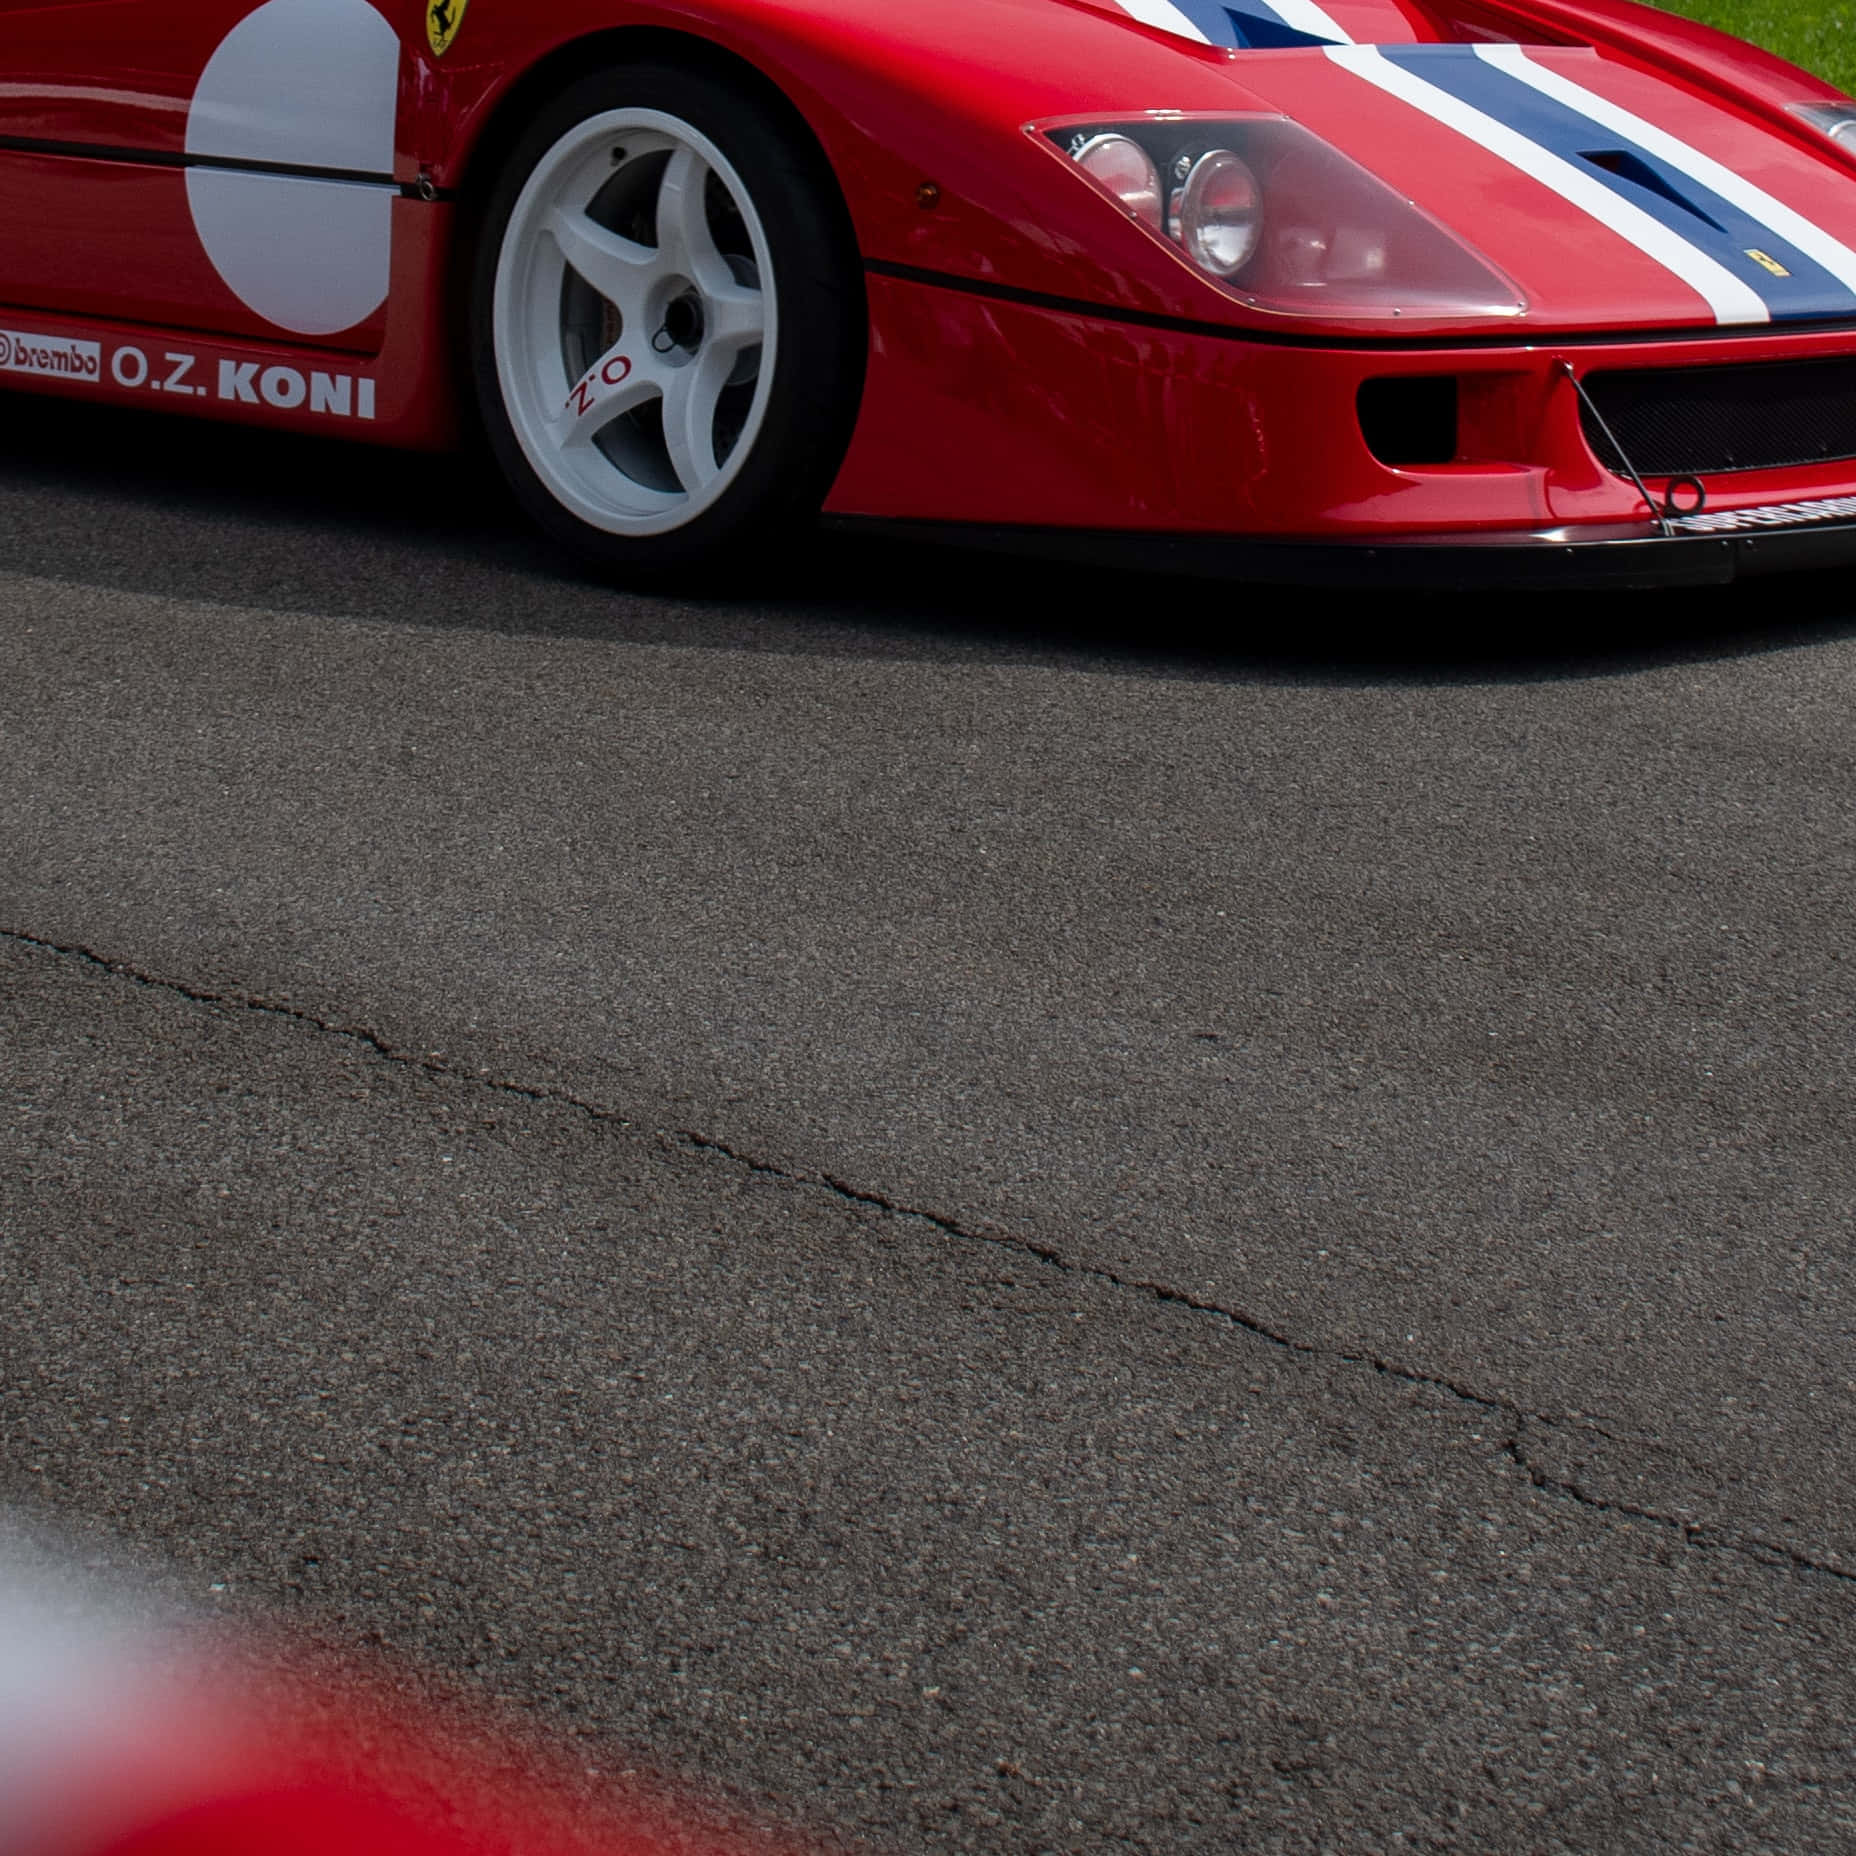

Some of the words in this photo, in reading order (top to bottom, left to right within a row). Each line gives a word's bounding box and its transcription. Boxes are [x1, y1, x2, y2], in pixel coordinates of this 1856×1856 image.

[14, 337, 97, 375] brembo
[111, 346, 207, 396] O.Z.
[217, 358, 376, 419] KONI
[564, 354, 632, 417] O.Z.
